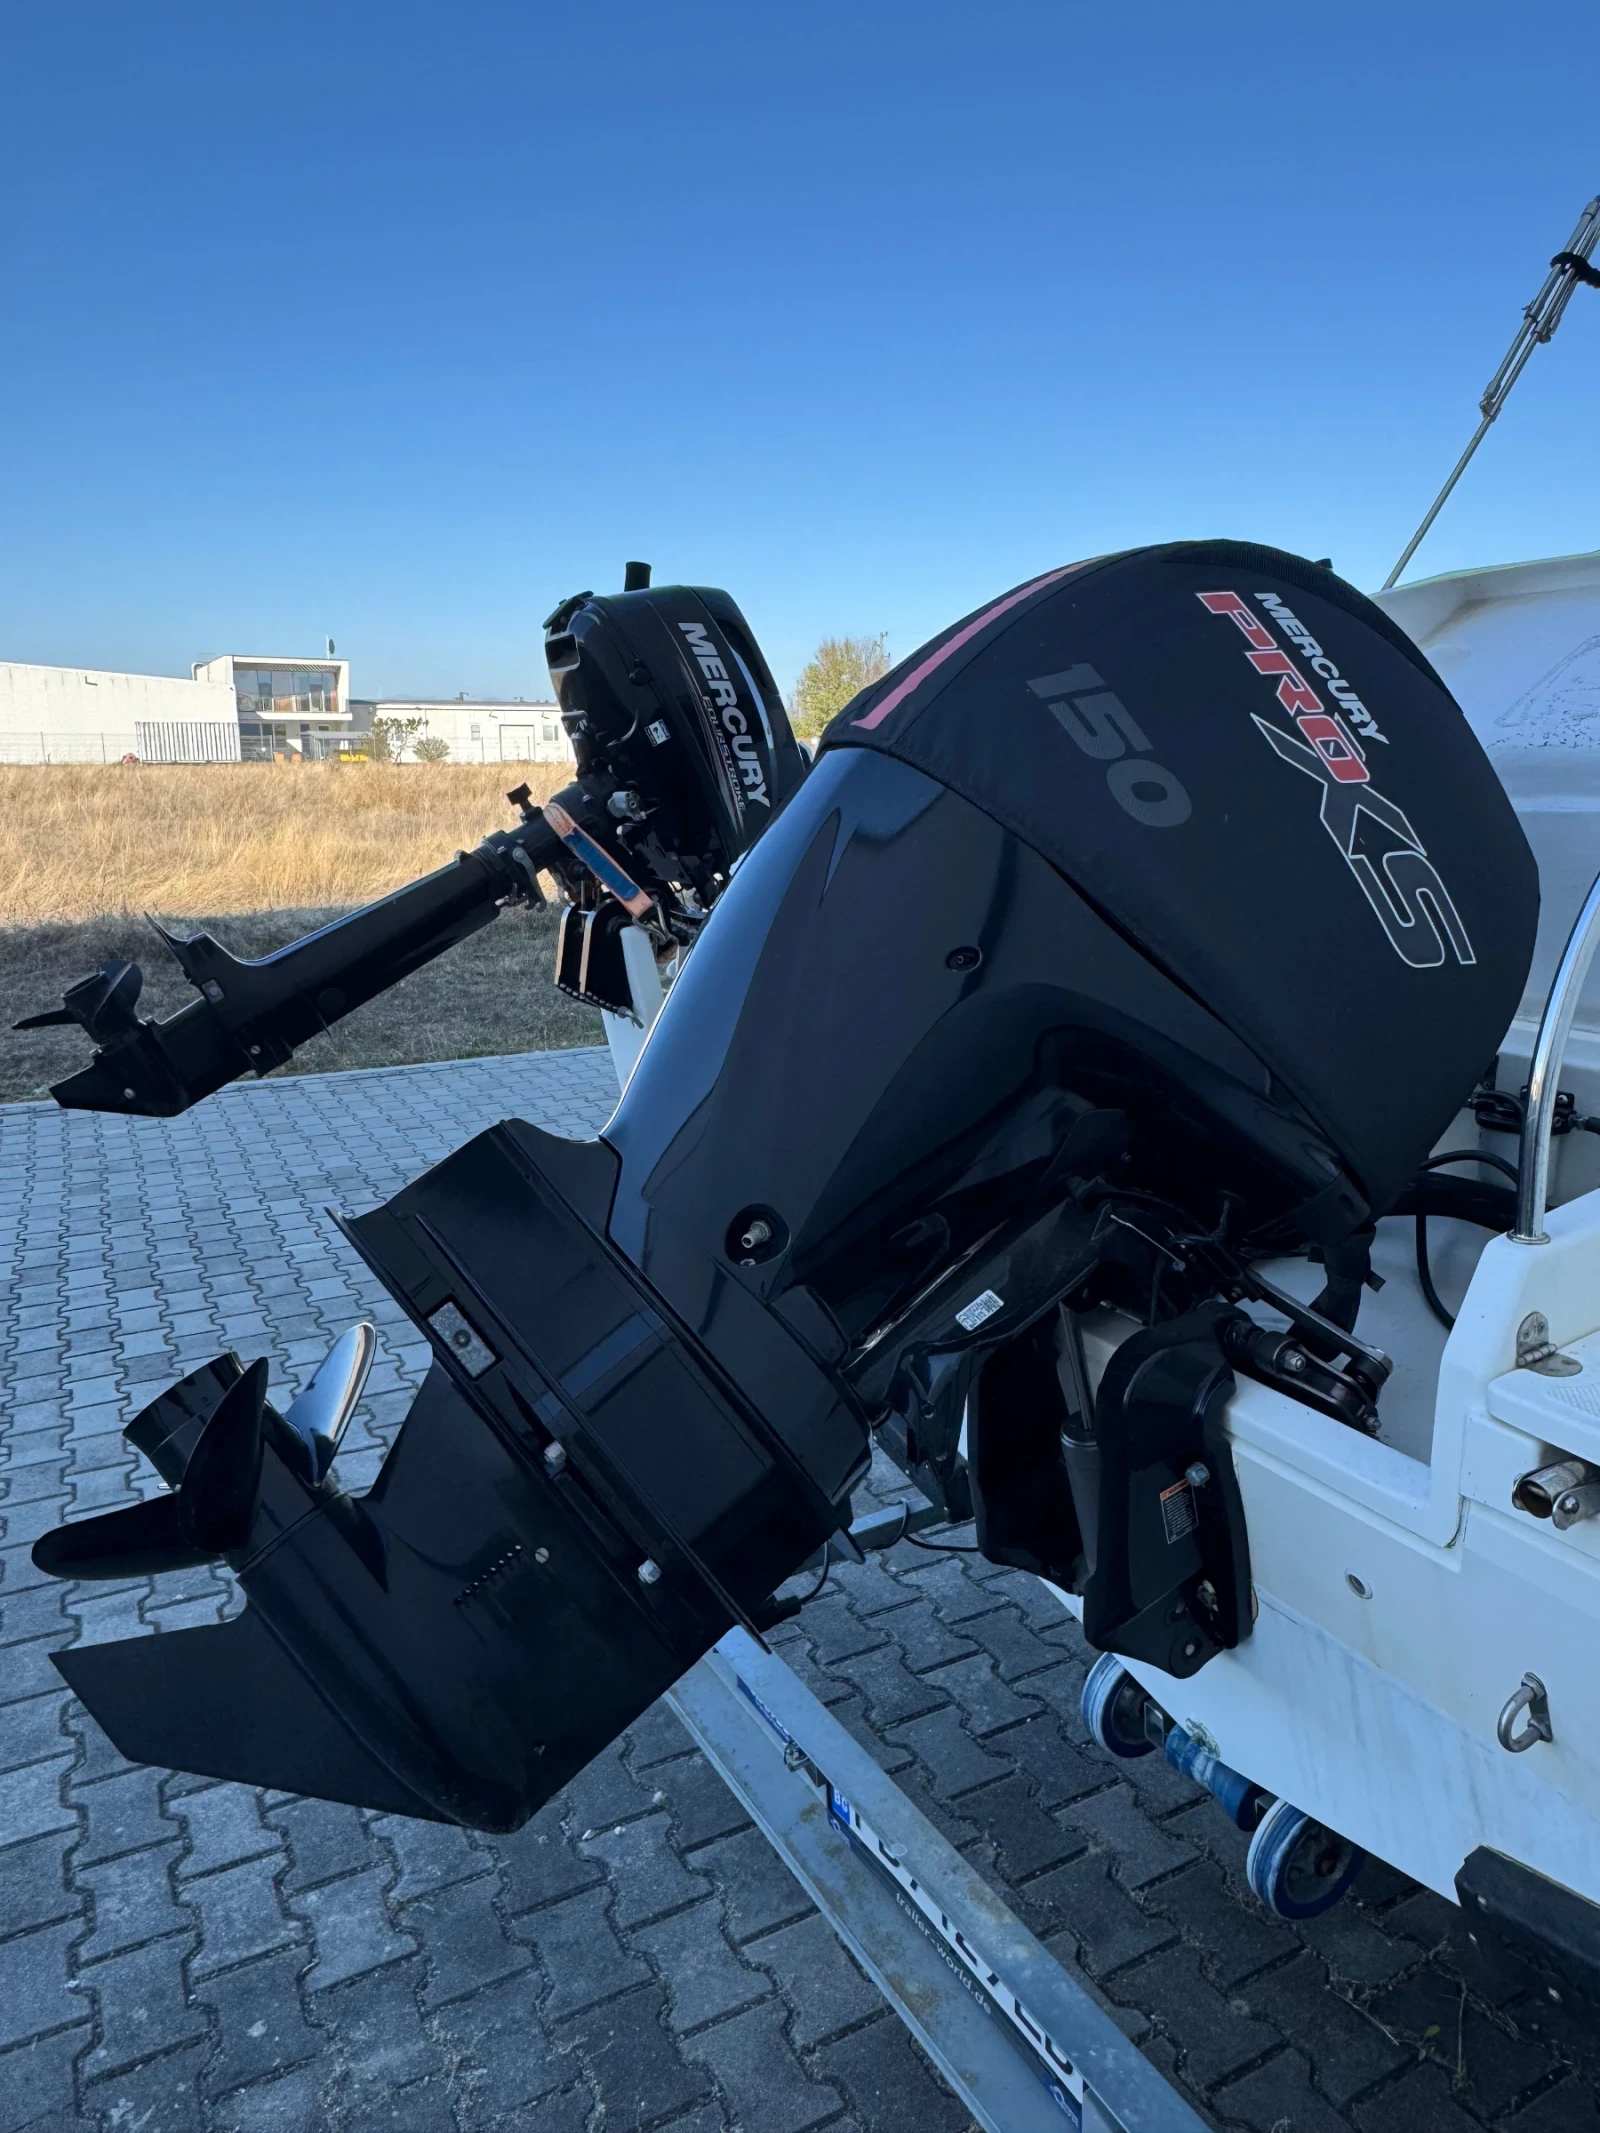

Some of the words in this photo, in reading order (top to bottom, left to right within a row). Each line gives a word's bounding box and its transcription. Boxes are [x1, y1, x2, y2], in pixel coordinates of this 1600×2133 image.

[678, 622, 770, 808] MERCURY
[1026, 663, 1192, 827] 150
[1195, 591, 1370, 783] PRO
[1254, 593, 1389, 744] MERCURY
[702, 696, 746, 811] FOURSTROKE
[1250, 712, 1477, 967] XS
[895, 1893, 992, 2014] trailer-world.de
